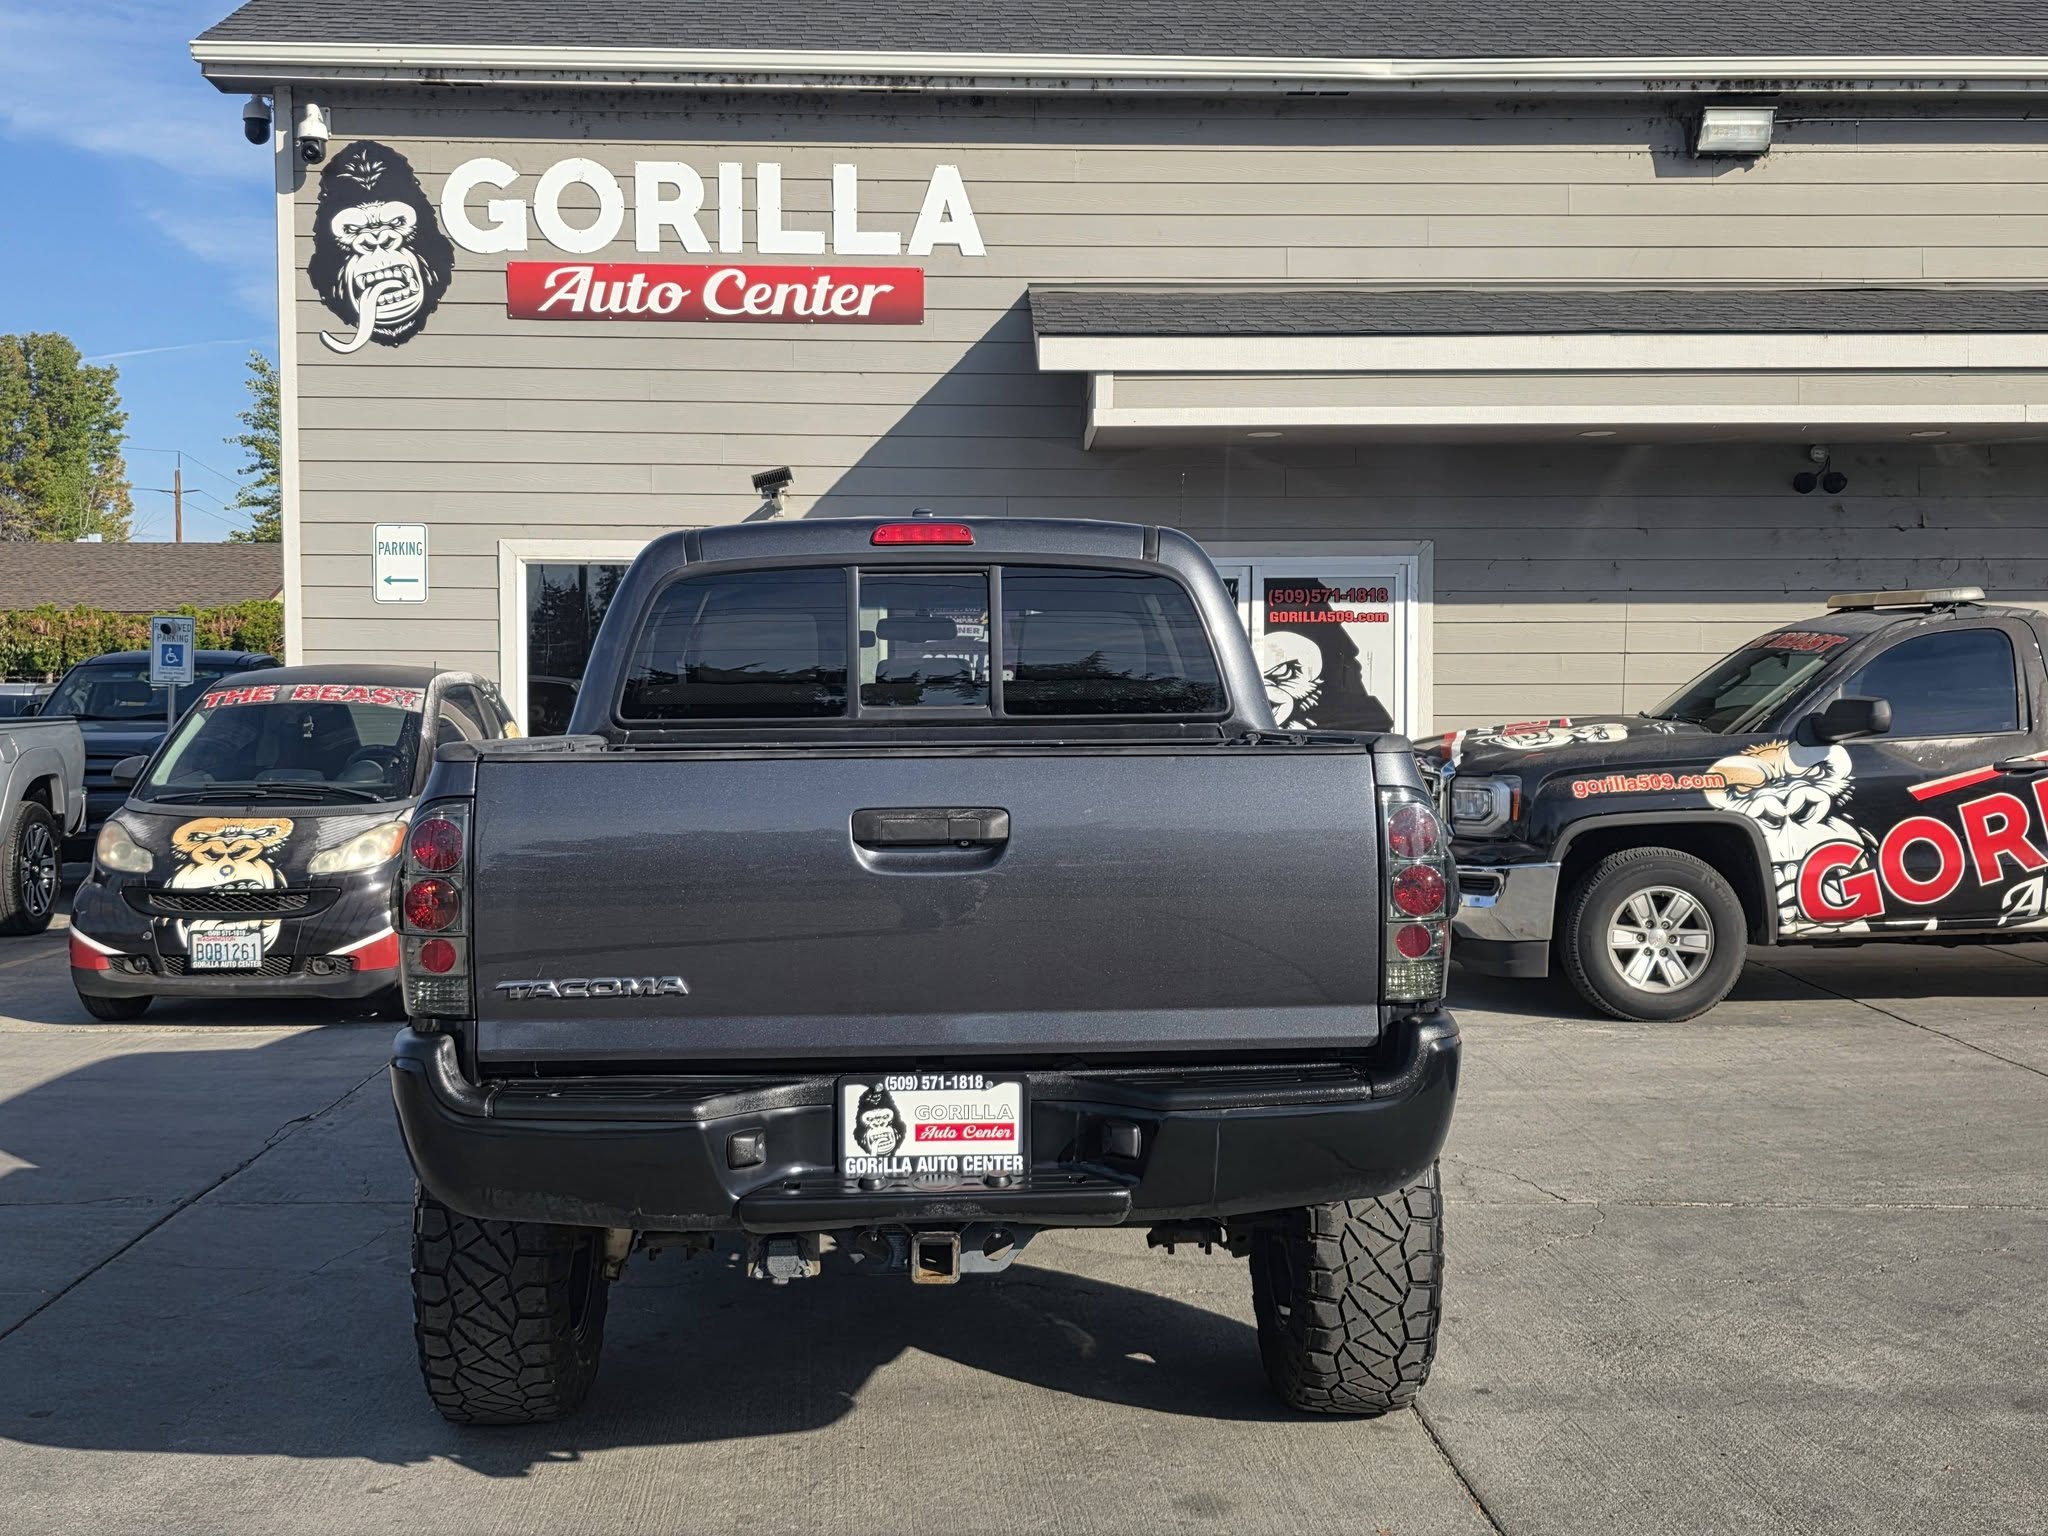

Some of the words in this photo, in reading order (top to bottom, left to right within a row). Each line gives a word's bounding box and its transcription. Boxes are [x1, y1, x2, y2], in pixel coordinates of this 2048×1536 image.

[440, 157, 988, 256] GORILLA
[537, 266, 691, 314] Auto
[703, 268, 894, 317] Center
[378, 541, 423, 556] PARKING
[1268, 587, 1389, 607] (509)571-1818
[1269, 611, 1389, 623] GORILLA509.com
[154, 622, 192, 633] RVED
[156, 633, 189, 643] PARKING
[202, 685, 281, 709] THE
[290, 684, 424, 707] BEAST
[1572, 772, 1726, 800] gorilla509.com
[1997, 876, 2048, 925] A
[238, 960, 262, 968] CENTER
[495, 976, 689, 999] TACOMA
[885, 1075, 918, 1091] (509)
[922, 1075, 983, 1089] 571-1818
[915, 1104, 1014, 1120] GORILLA
[920, 1125, 958, 1140] Auto
[963, 1125, 1012, 1139] Center
[845, 1156, 912, 1173] GORILLA
[917, 1156, 958, 1172] AUTO
[963, 1155, 1024, 1171] CENTER
